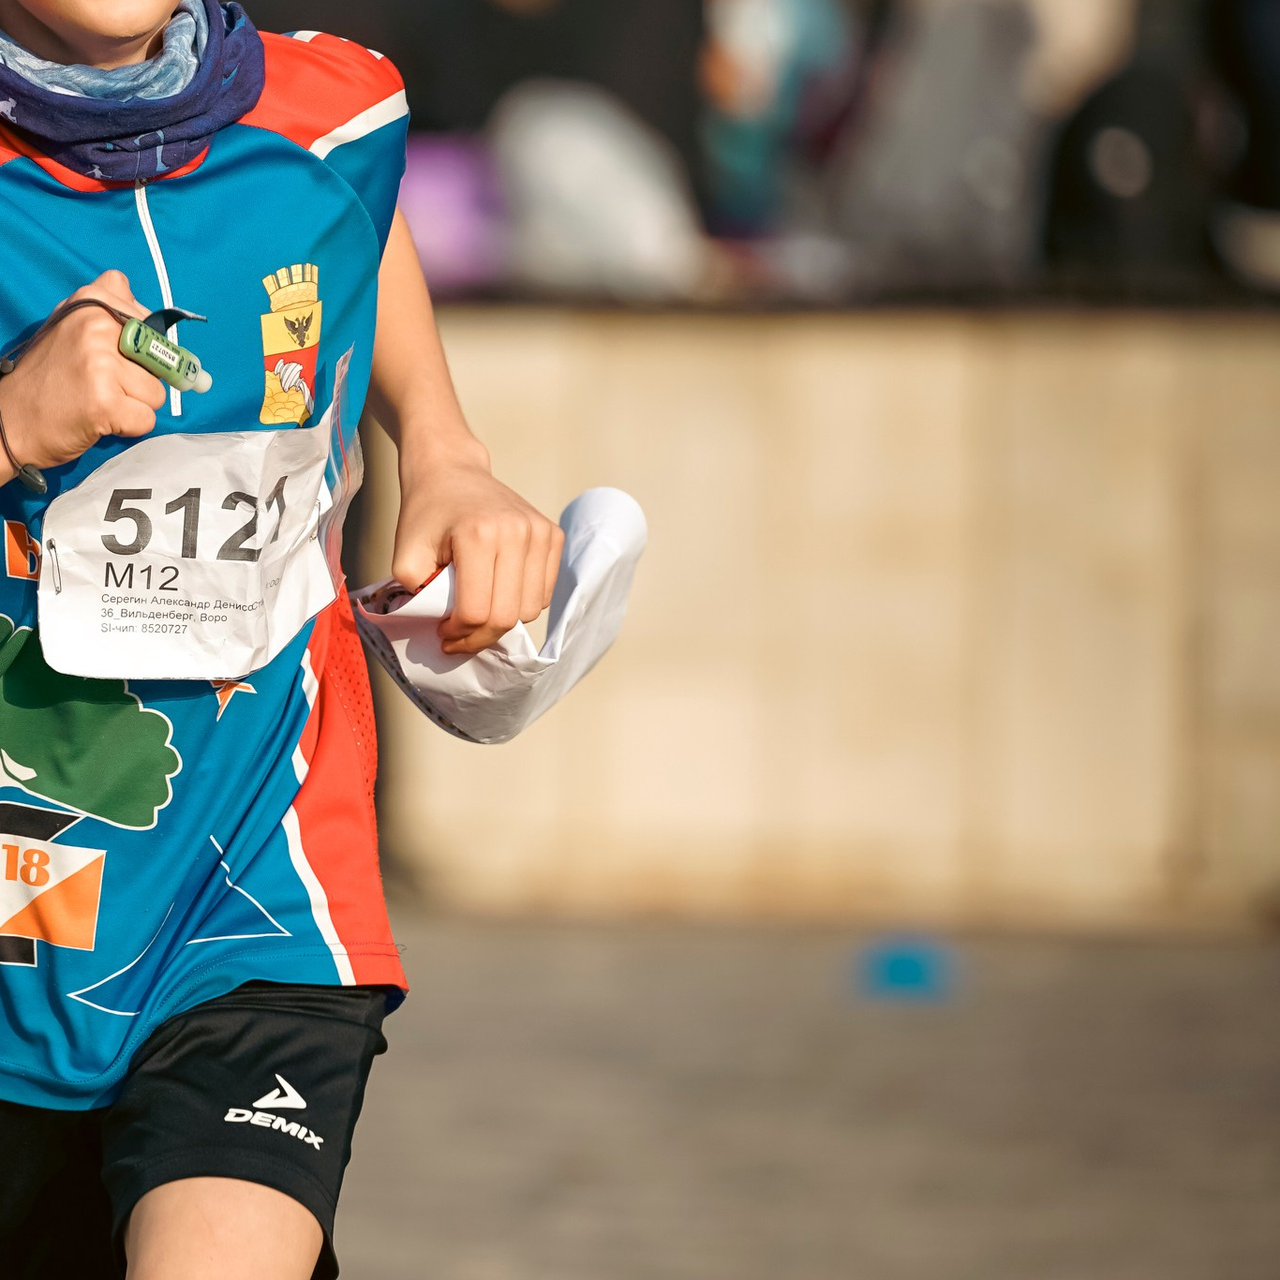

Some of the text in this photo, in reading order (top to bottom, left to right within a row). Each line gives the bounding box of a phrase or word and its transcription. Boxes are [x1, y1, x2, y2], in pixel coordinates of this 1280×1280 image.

[100, 475, 288, 563] 5121
[101, 593, 148, 606] Серегин
[150, 595, 211, 611] Александр
[141, 623, 188, 635] 8520727
[199, 612, 229, 624] Воро
[2, 844, 51, 887] 18
[224, 1107, 325, 1151] DEMIX
